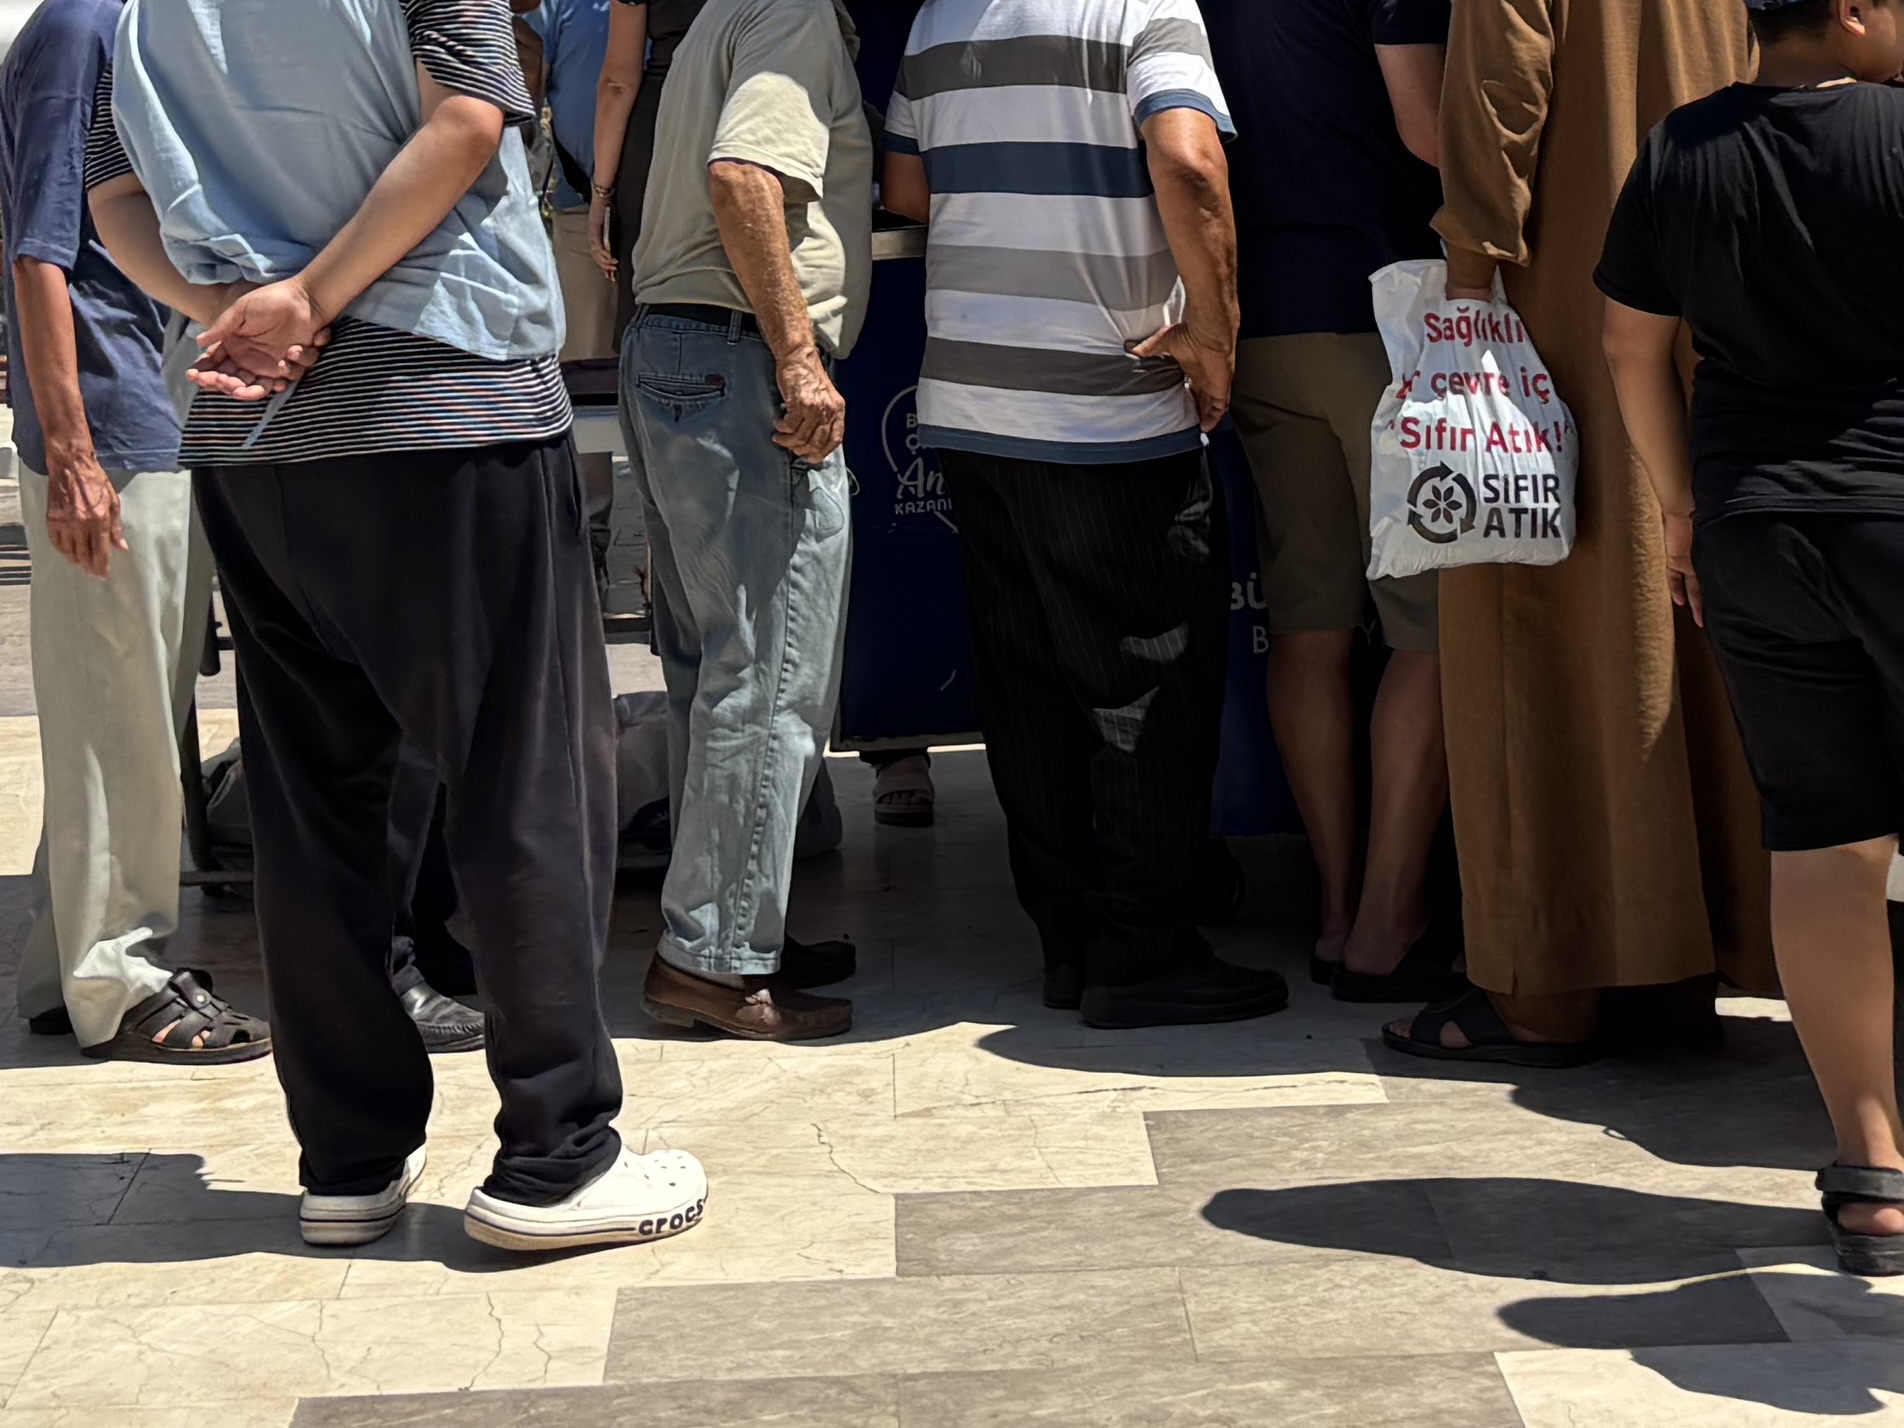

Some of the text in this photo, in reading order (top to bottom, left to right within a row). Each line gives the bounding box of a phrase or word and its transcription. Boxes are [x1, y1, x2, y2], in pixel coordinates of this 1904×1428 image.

[1424, 306, 1525, 347] Sağlıklı
[1430, 372, 1511, 400] çevre
[1483, 473, 1561, 504] SIFIR
[1483, 506, 1561, 539] ATIK
[639, 1198, 704, 1236] crocs
